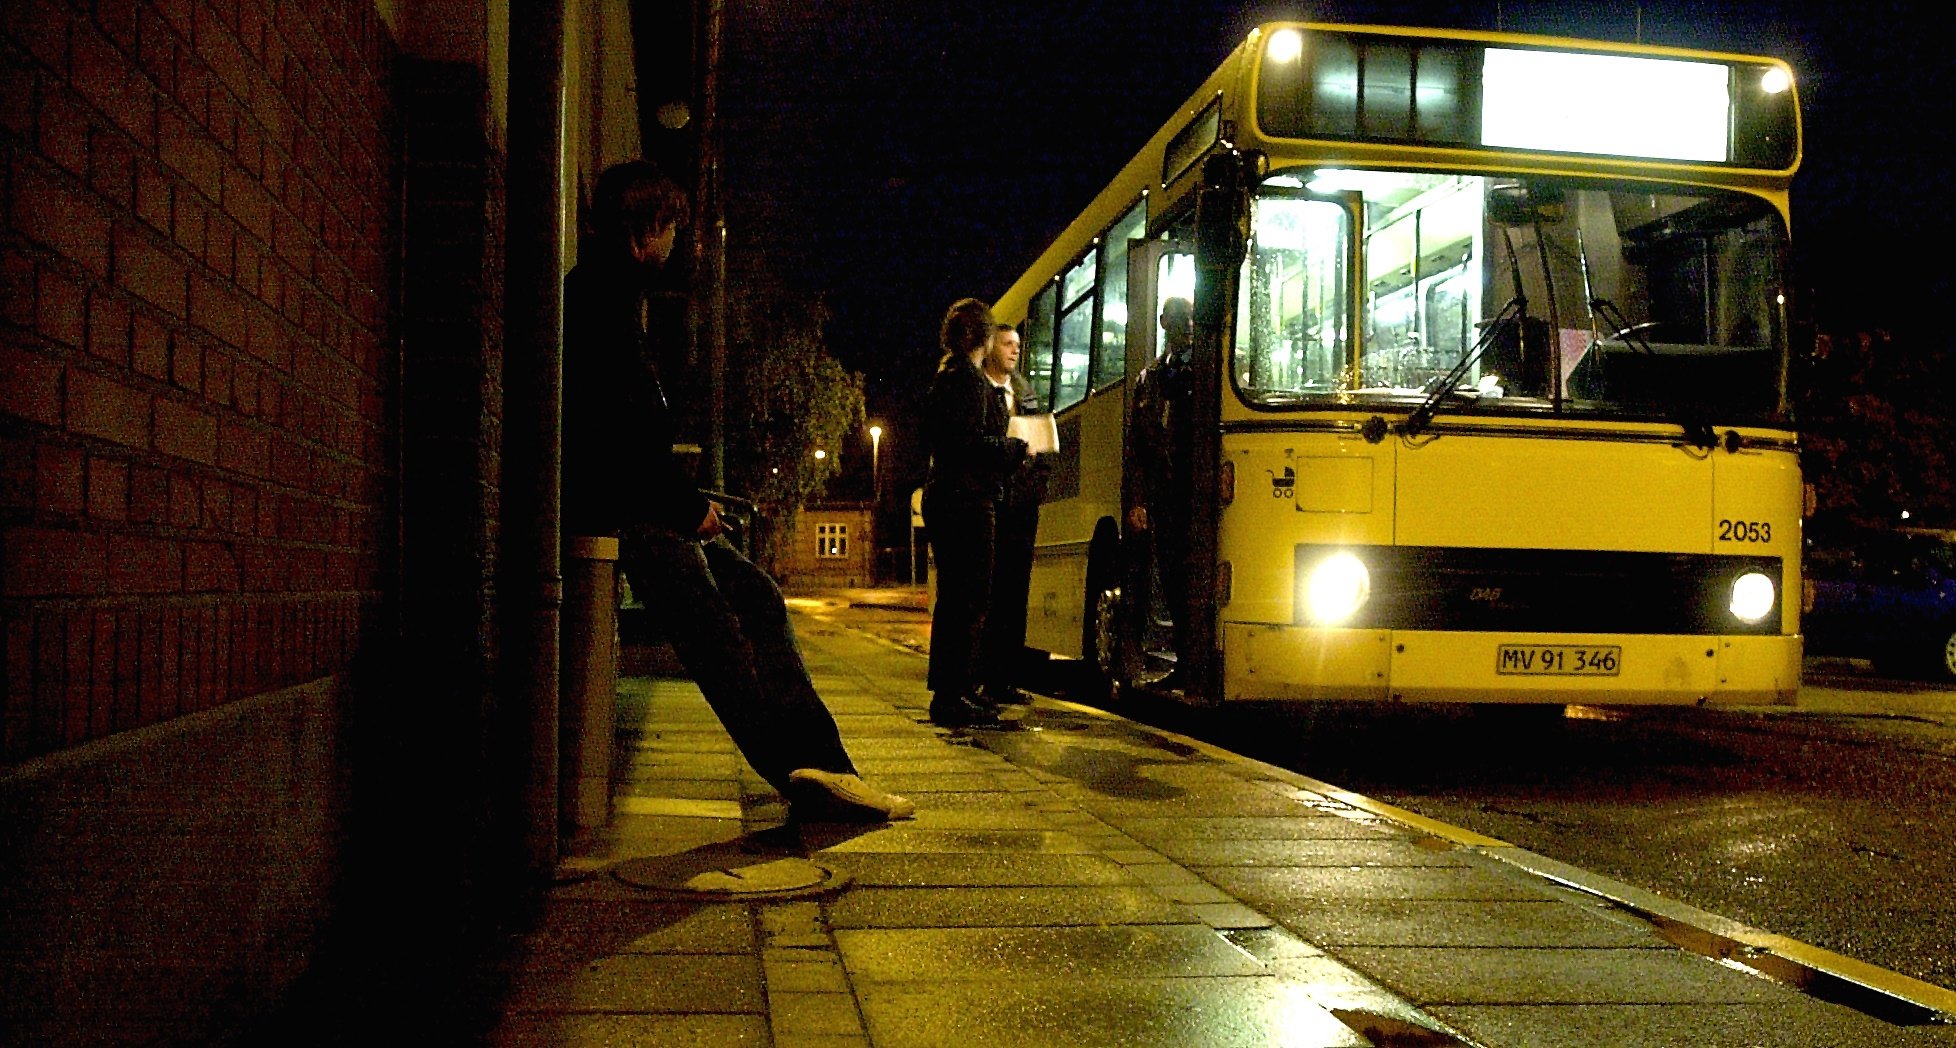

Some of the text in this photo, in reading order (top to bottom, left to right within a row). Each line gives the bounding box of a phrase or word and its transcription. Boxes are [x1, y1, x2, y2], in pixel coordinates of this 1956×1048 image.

[1719, 519, 1771, 543] 2053
[1502, 649, 1616, 671] MV 91 346
